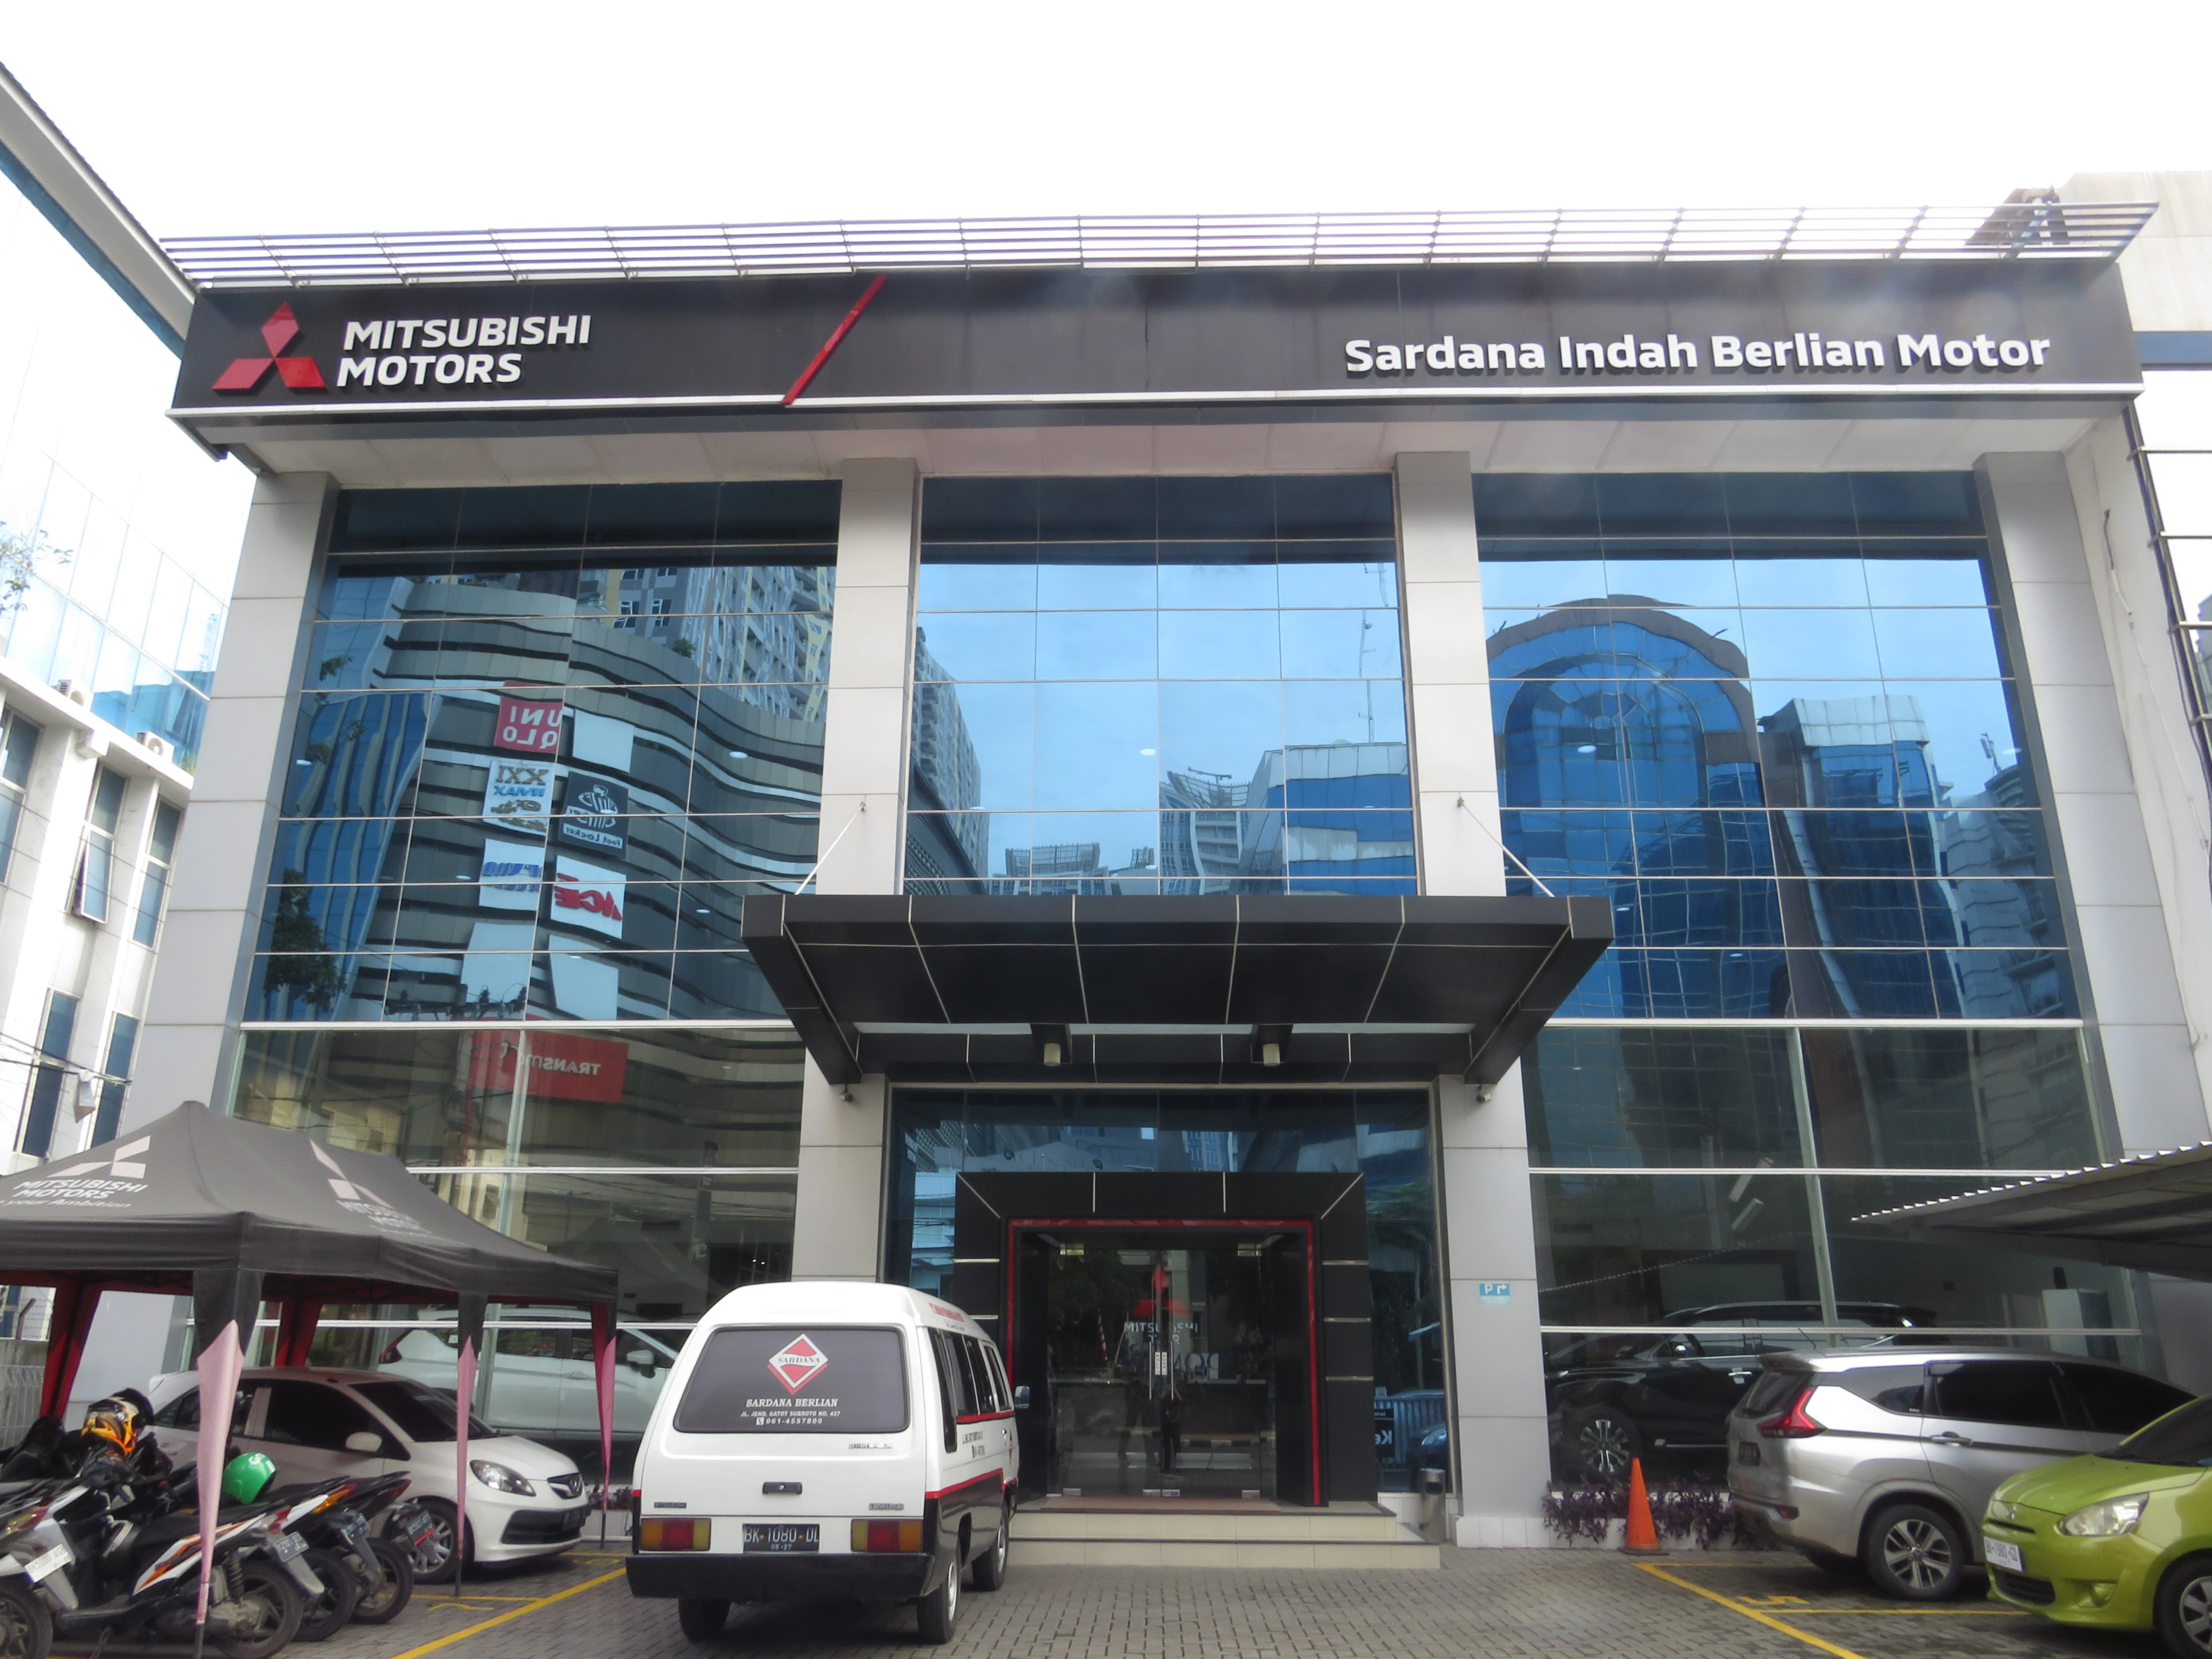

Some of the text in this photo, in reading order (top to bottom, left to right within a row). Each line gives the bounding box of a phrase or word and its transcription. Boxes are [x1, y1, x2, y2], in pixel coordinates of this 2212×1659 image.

[343, 315, 591, 350] MITSUBISHI
[1345, 332, 2051, 371] Sardana Indah Berlian Motor
[337, 353, 522, 387] MOTORS
[13, 1179, 149, 1193] MITSUBISHI
[13, 1189, 115, 1199] MOTORS
[1485, 1284, 1493, 1295] P
[746, 1398, 838, 1407] SARDANA BERLIAN
[744, 1527, 760, 1543] BK
[767, 1527, 797, 1543] 1080
